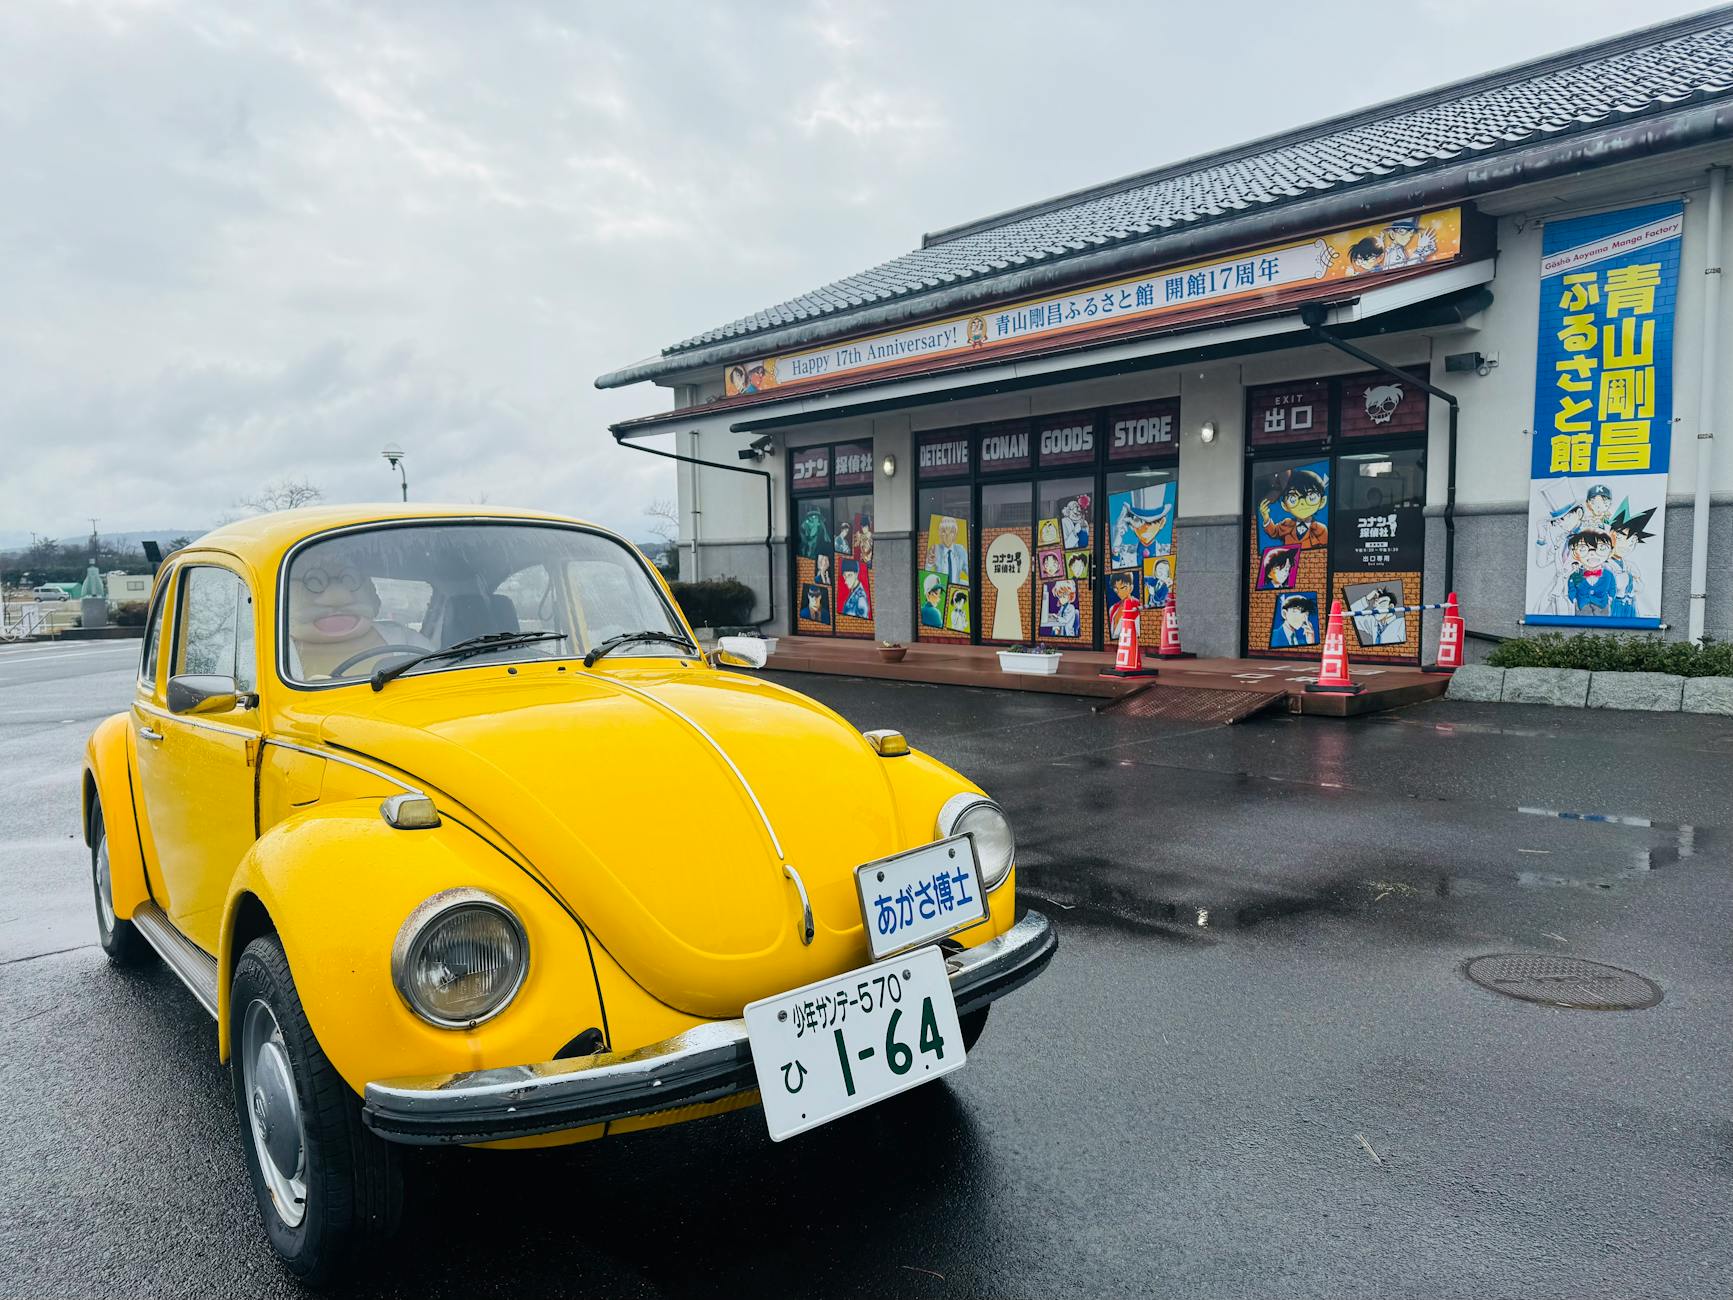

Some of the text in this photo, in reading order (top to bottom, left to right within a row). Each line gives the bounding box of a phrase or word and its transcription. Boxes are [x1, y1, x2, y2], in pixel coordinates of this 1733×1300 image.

[1573, 246, 1609, 261] Aoyama
[1611, 235, 1643, 250] Manga
[1645, 223, 1680, 239] Factory
[995, 256, 1281, 337] 青山剛昌ふるさと館 開館17周年
[792, 326, 958, 375] Happy 17th Anniversary!
[1596, 262, 1661, 471] 青山剛昌
[1549, 273, 1600, 473] ふるさと館
[1265, 405, 1313, 432] 出口
[1275, 394, 1304, 405] EXIT
[920, 415, 1172, 467] DETECTIVE CONAN GOODS STORE
[793, 453, 873, 480] コナン 探偵社
[1357, 516, 1387, 528] コナン
[992, 553, 1014, 563] コナン
[1116, 627, 1132, 666] 出口
[1166, 612, 1180, 644] 出口
[1438, 622, 1458, 662] 出口
[1321, 633, 1343, 677] 出口
[874, 866, 973, 935] あがさ博士
[793, 973, 902, 1038] 少年サンデー570
[780, 996, 945, 1097] ひ 1-64
